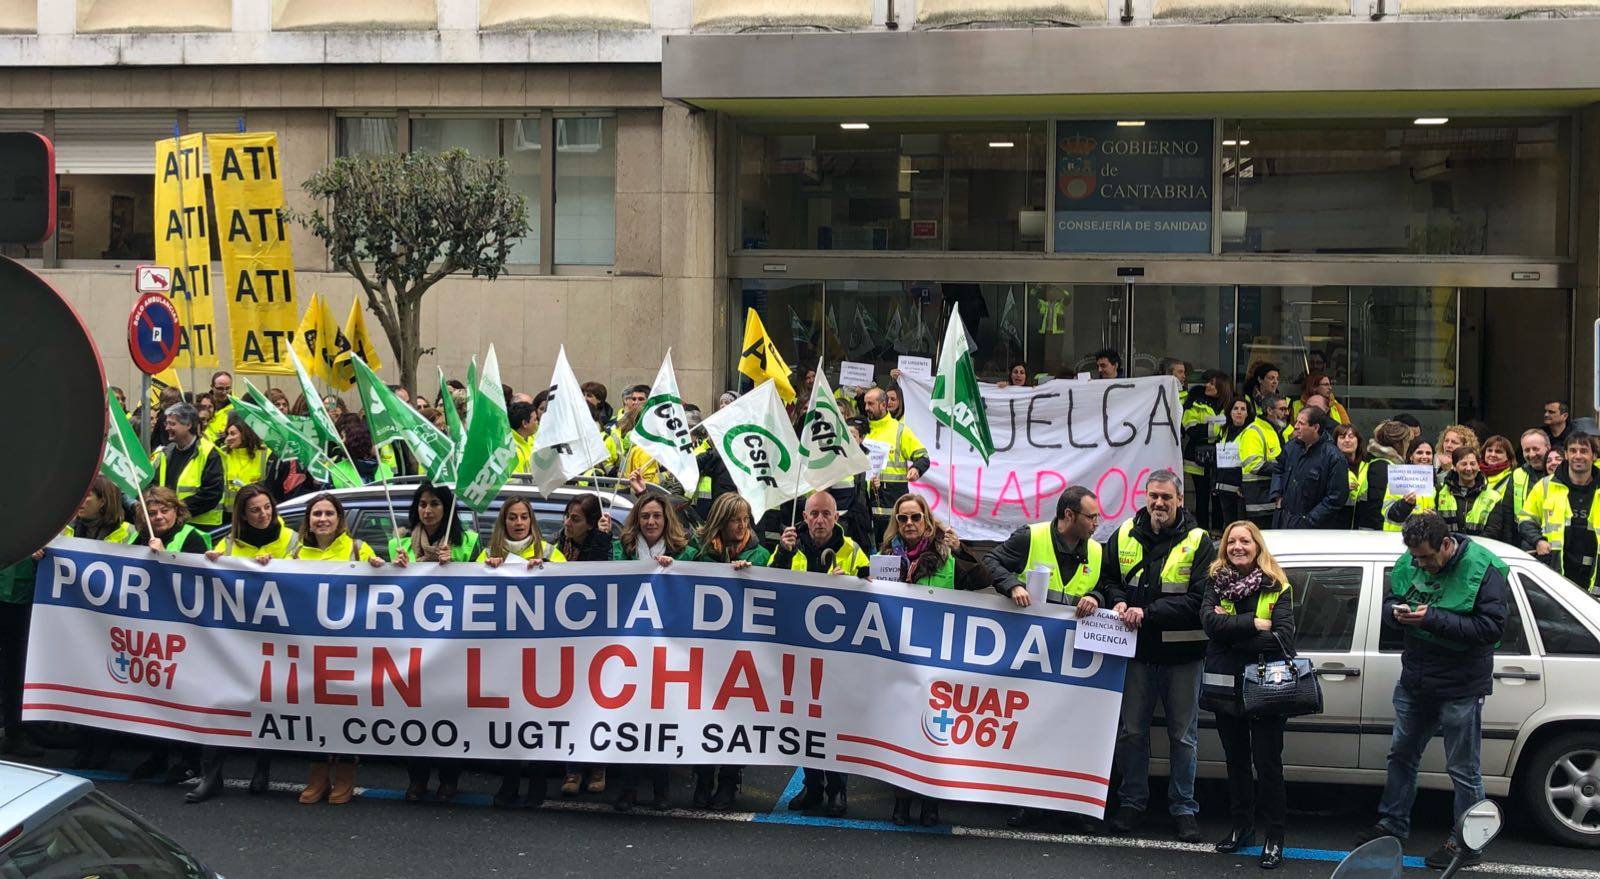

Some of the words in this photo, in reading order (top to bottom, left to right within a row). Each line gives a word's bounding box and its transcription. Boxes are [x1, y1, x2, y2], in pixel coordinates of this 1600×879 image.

[164, 147, 200, 183] ATI
[221, 146, 278, 182] ATI
[1101, 140, 1199, 156] GOBIERNO
[1101, 162, 1118, 177] de
[1100, 184, 1208, 199] CANTABRIA
[166, 206, 206, 242] ATI
[228, 208, 287, 242] ATI
[1058, 218, 1132, 232] CONSEJERÍA
[1136, 221, 1150, 232] DE
[1154, 221, 1207, 232] SANIDAD
[170, 264, 210, 298] ATI
[235, 269, 292, 303] ATI
[133, 305, 144, 326] SOLO
[144, 296, 178, 323] AMBULANCIAS
[154, 330, 160, 338] P
[176, 324, 214, 356] ATI
[52, 556, 152, 612] POR
[172, 572, 290, 628] UNA
[316, 582, 664, 632] URGENCIA
[692, 584, 777, 636] DE
[804, 594, 1104, 678] CALIDAD
[1082, 620, 1114, 630] PACIENCIA
[110, 626, 186, 661] SUAP
[1084, 632, 1128, 646] URGENCIA
[260, 642, 422, 708] ¡¡EN
[466, 644, 824, 719] LUCHA!!
[928, 680, 1030, 720] SUAP
[258, 713, 326, 747] ATI,
[342, 717, 470, 753] CCOO,
[488, 721, 574, 756] UGT,
[590, 721, 684, 758] CSIF,
[701, 724, 827, 760] SATSE
